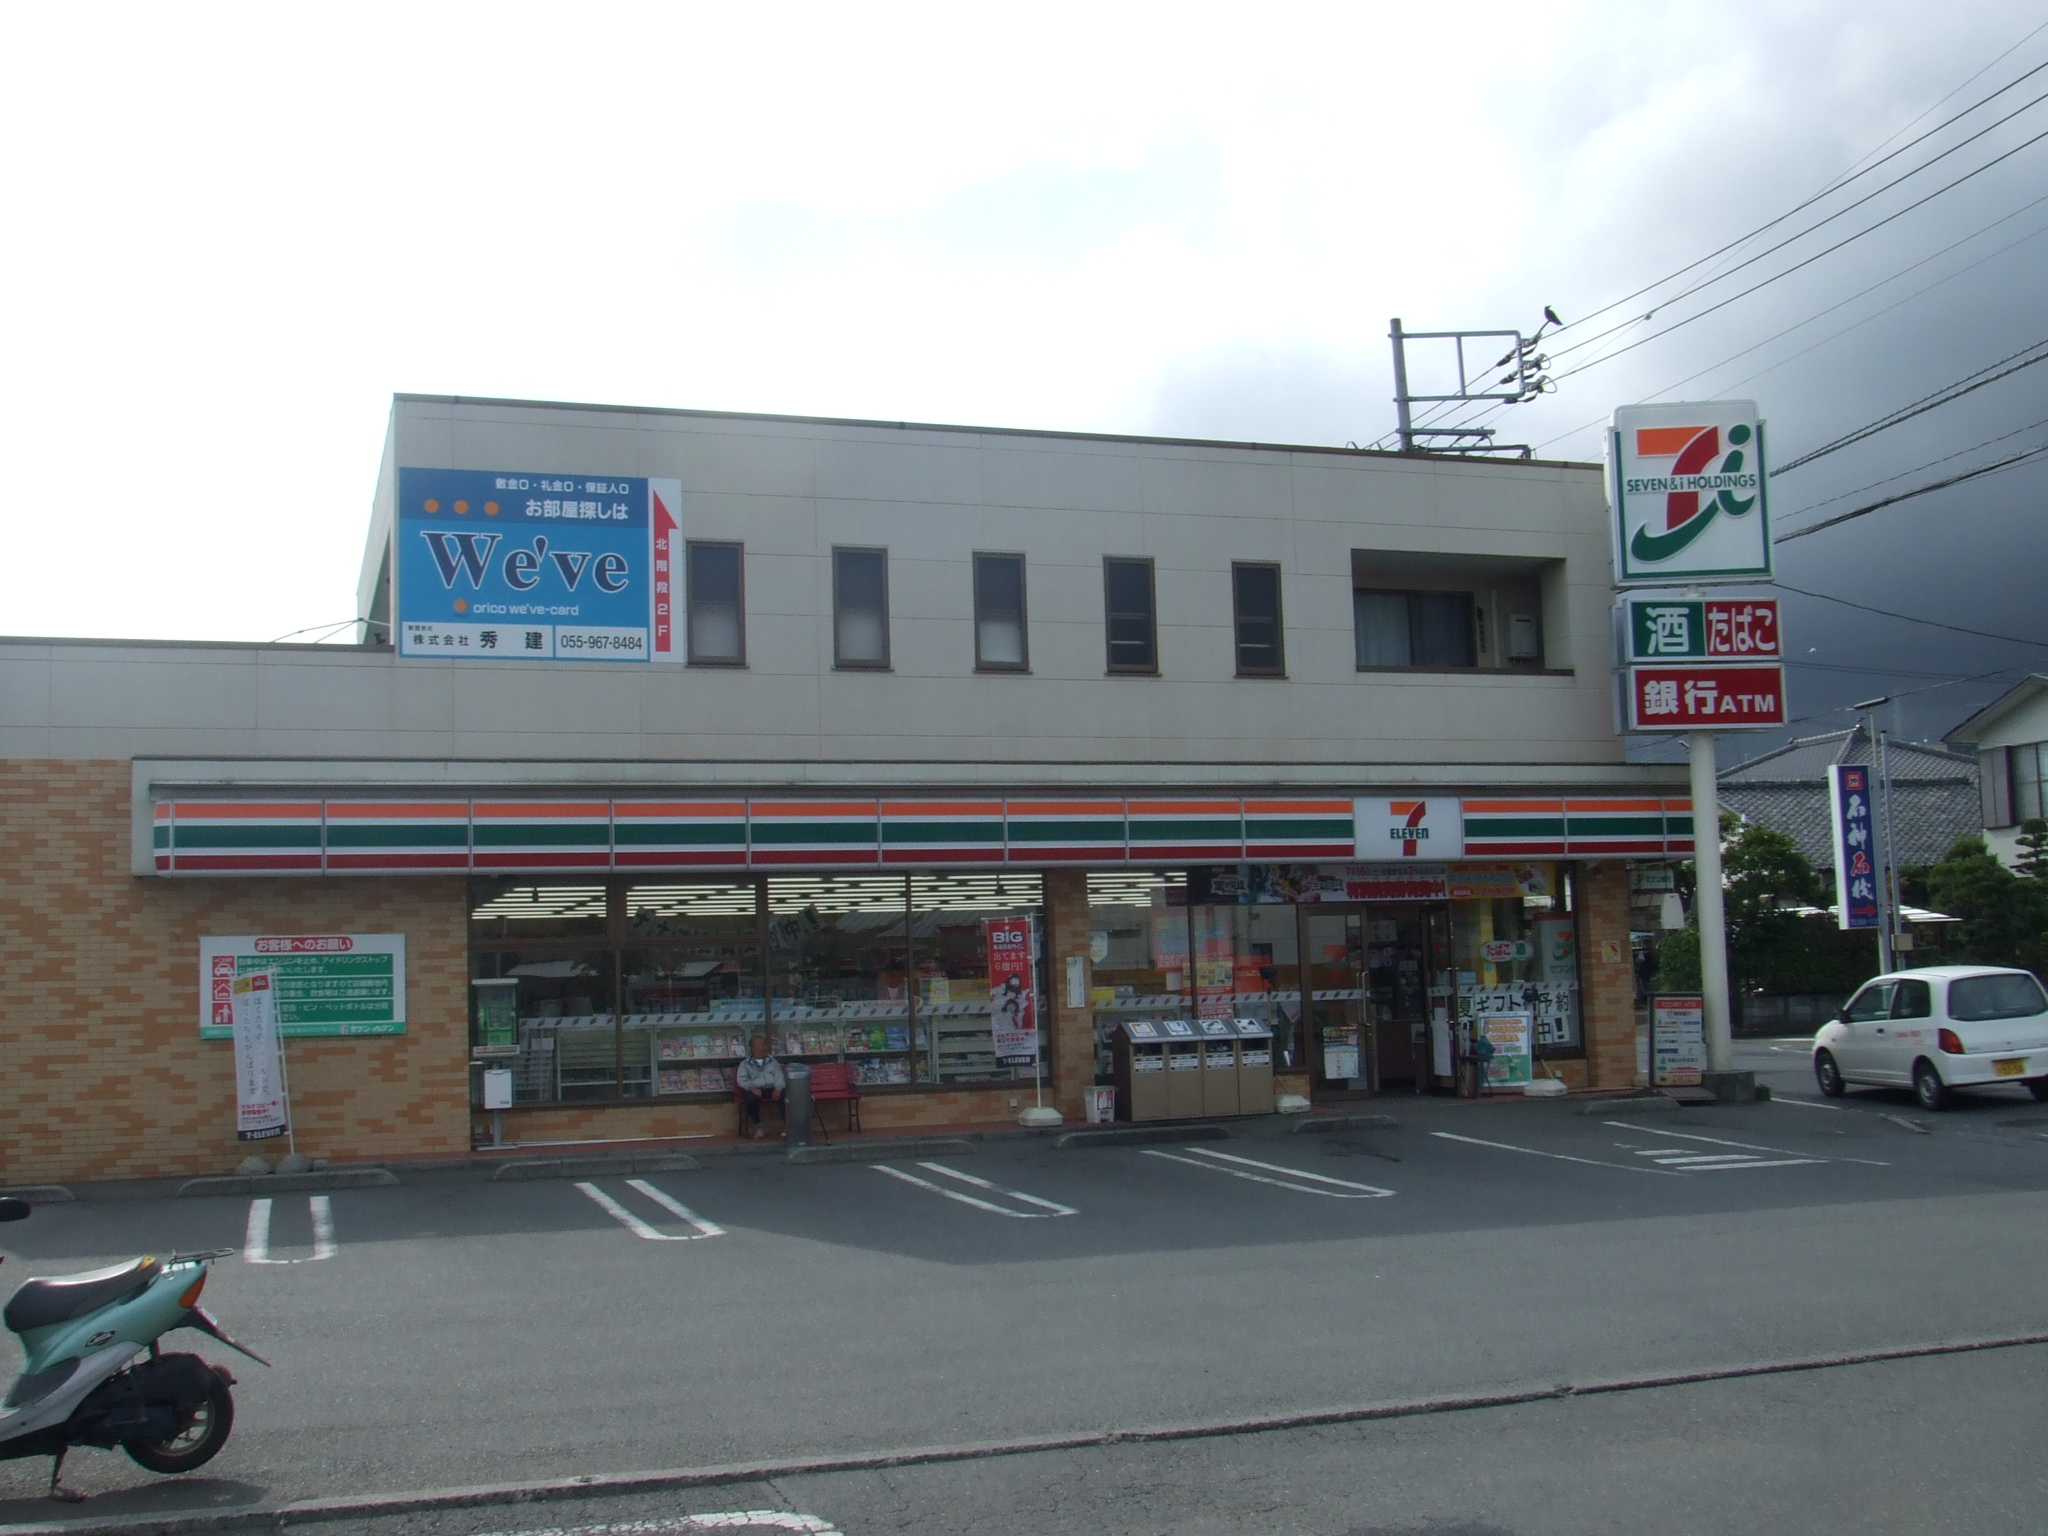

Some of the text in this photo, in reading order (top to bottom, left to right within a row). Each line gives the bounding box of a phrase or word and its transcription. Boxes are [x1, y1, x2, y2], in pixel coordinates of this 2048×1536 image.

[1688, 473, 1756, 491] HOLDINGS
[525, 499, 628, 520] お部屋探しは
[420, 530, 630, 593] We've
[655, 538, 669, 637] 北階段2F
[473, 603, 579, 616] orico we've-card
[1645, 605, 1777, 655] 酒 たばこ
[413, 633, 470, 647] 株式会社
[560, 634, 643, 650] 055-967-8484
[1643, 680, 1775, 716] 銀行 ATM
[256, 938, 351, 951] お客様へのお願い
[1486, 943, 1511, 956] たばこ
